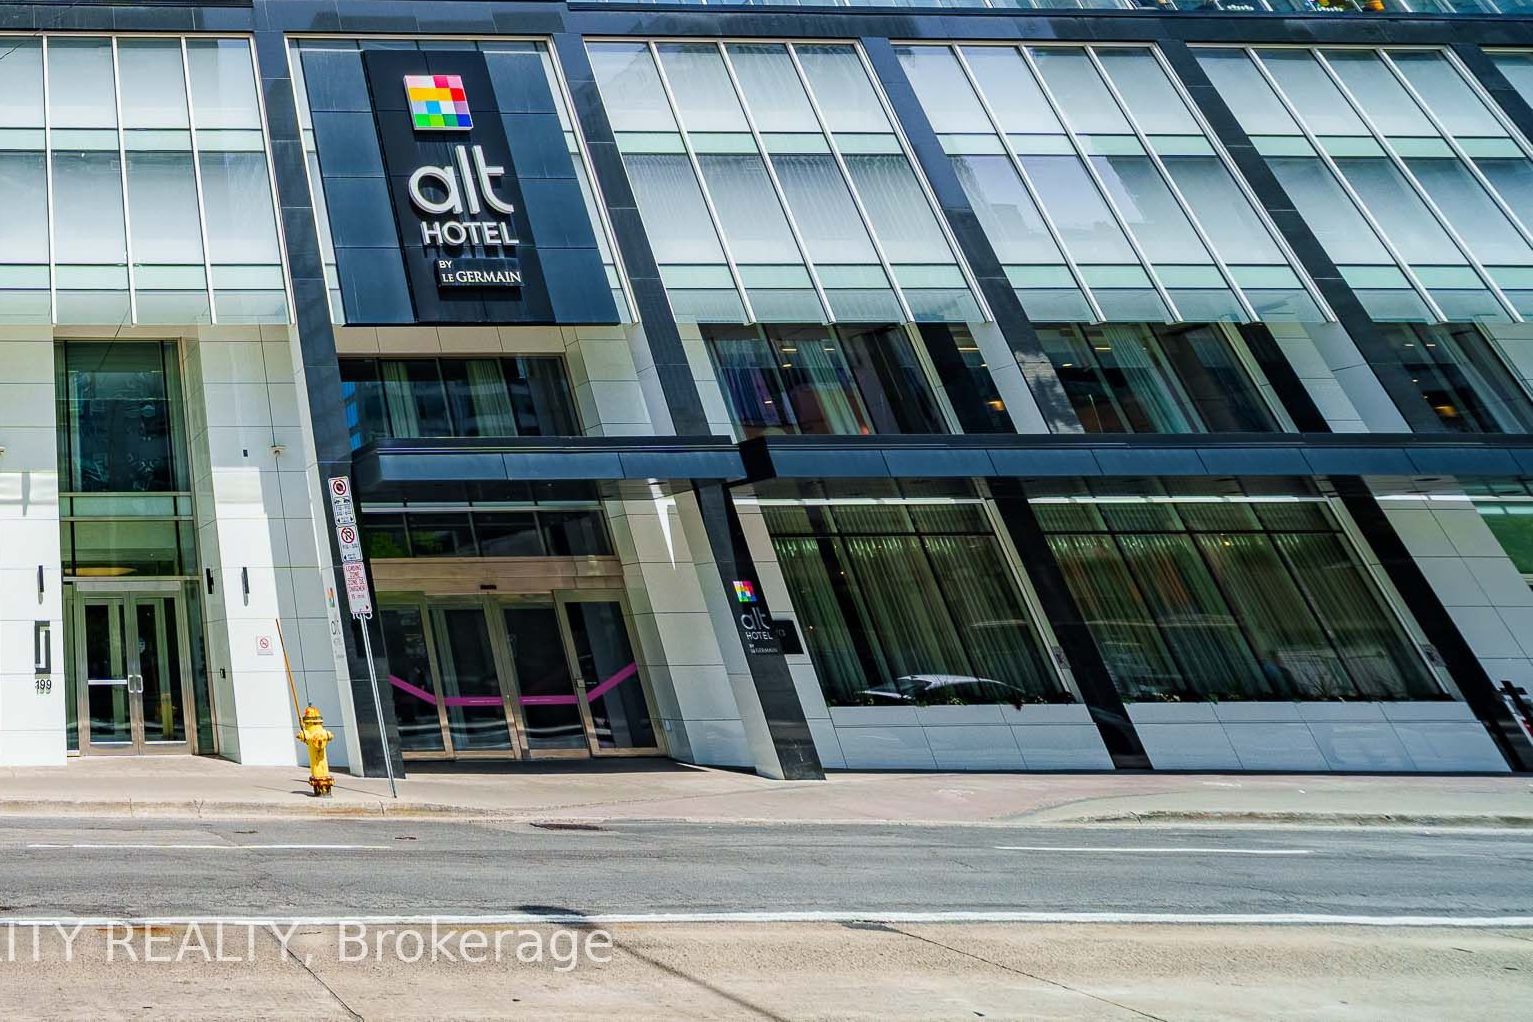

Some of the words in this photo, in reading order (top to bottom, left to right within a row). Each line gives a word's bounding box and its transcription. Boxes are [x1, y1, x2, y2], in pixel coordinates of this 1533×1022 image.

[409, 145, 514, 214] alt
[420, 221, 519, 246] HOTEL
[438, 260, 452, 269] BY
[441, 274, 454, 283] LE
[455, 271, 522, 283] GERMAIN
[740, 606, 770, 630] alt
[745, 631, 773, 640] HOTEL
[35, 679, 52, 690] 199
